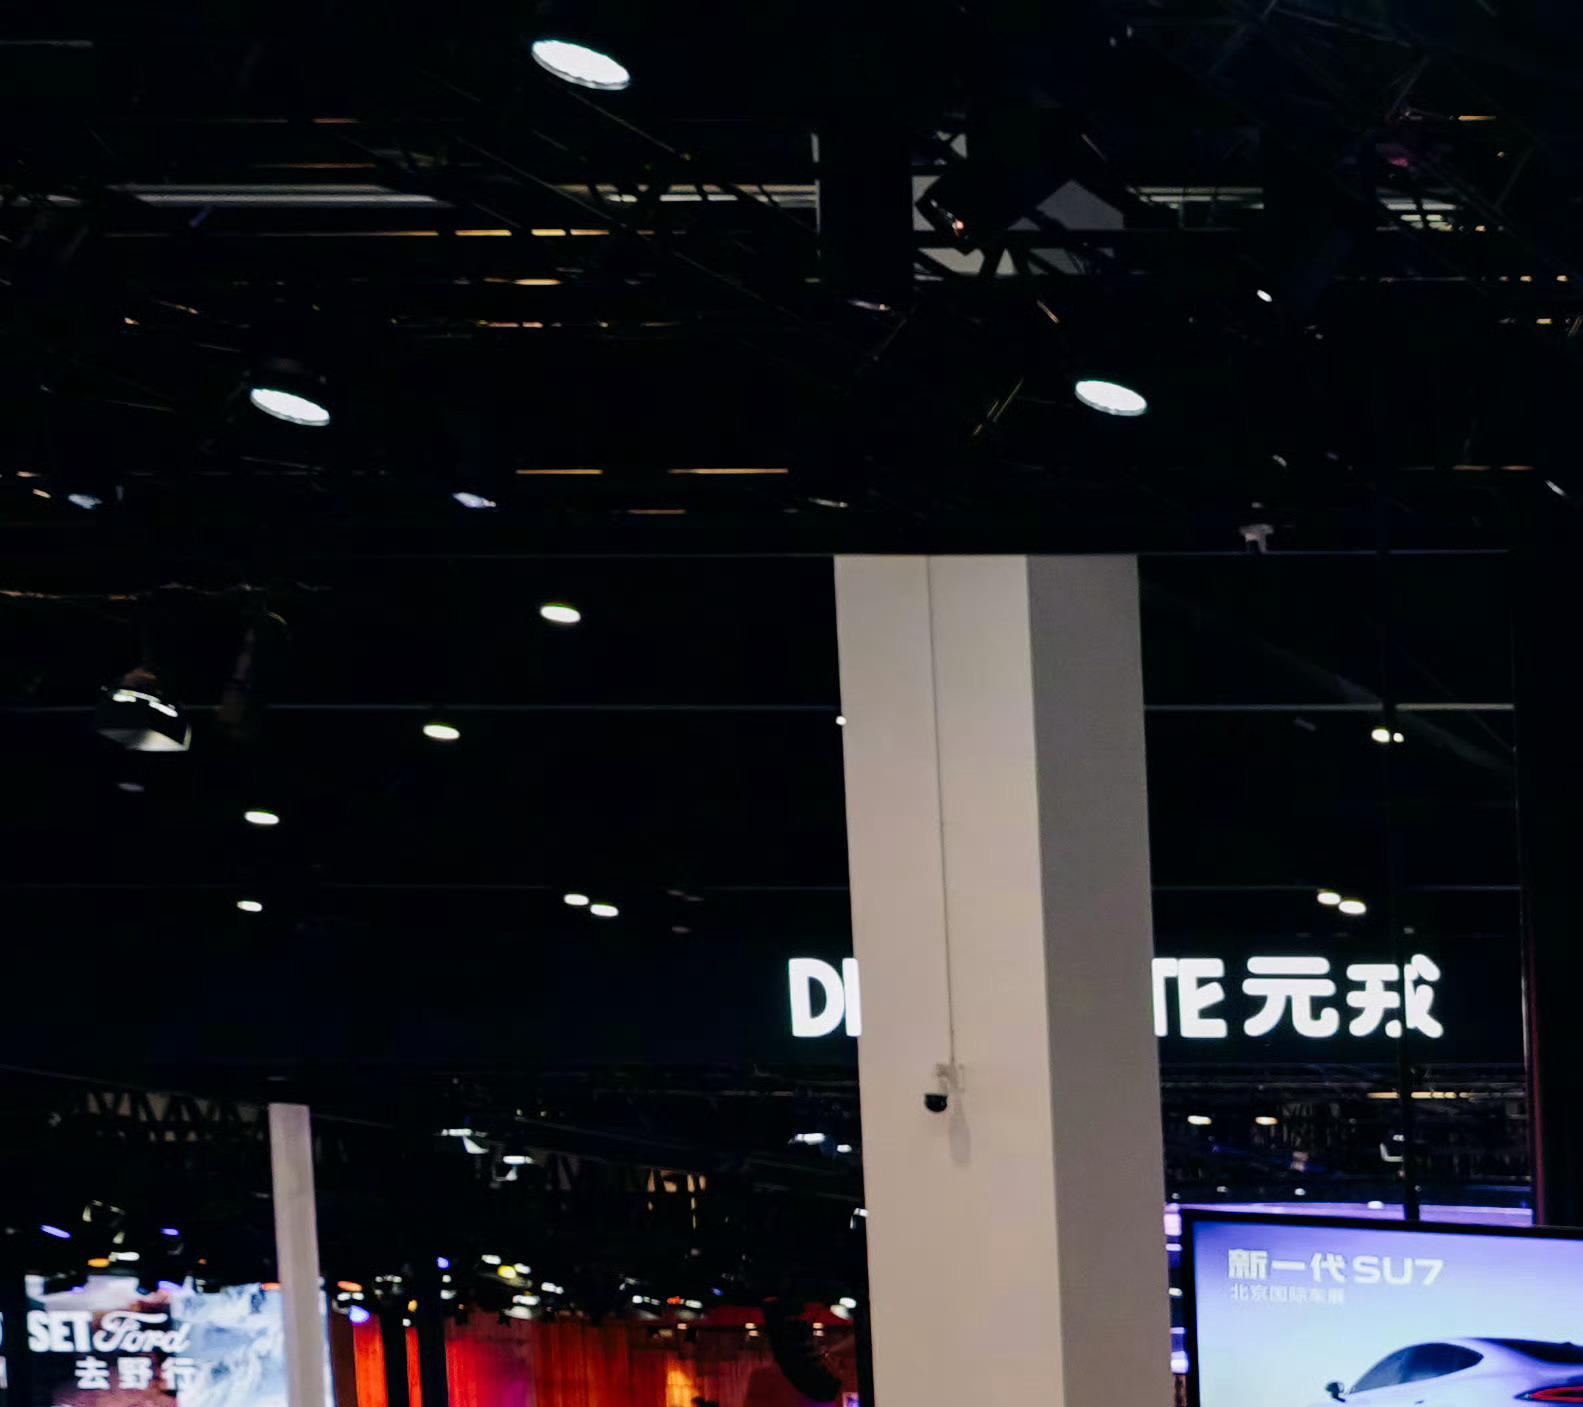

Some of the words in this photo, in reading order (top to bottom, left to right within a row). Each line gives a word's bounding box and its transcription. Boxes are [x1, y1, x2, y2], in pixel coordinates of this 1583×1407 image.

[1228, 1248, 1445, 1287] 新一代SU7
[27, 1310, 92, 1353] SET
[93, 1309, 192, 1353] Ford
